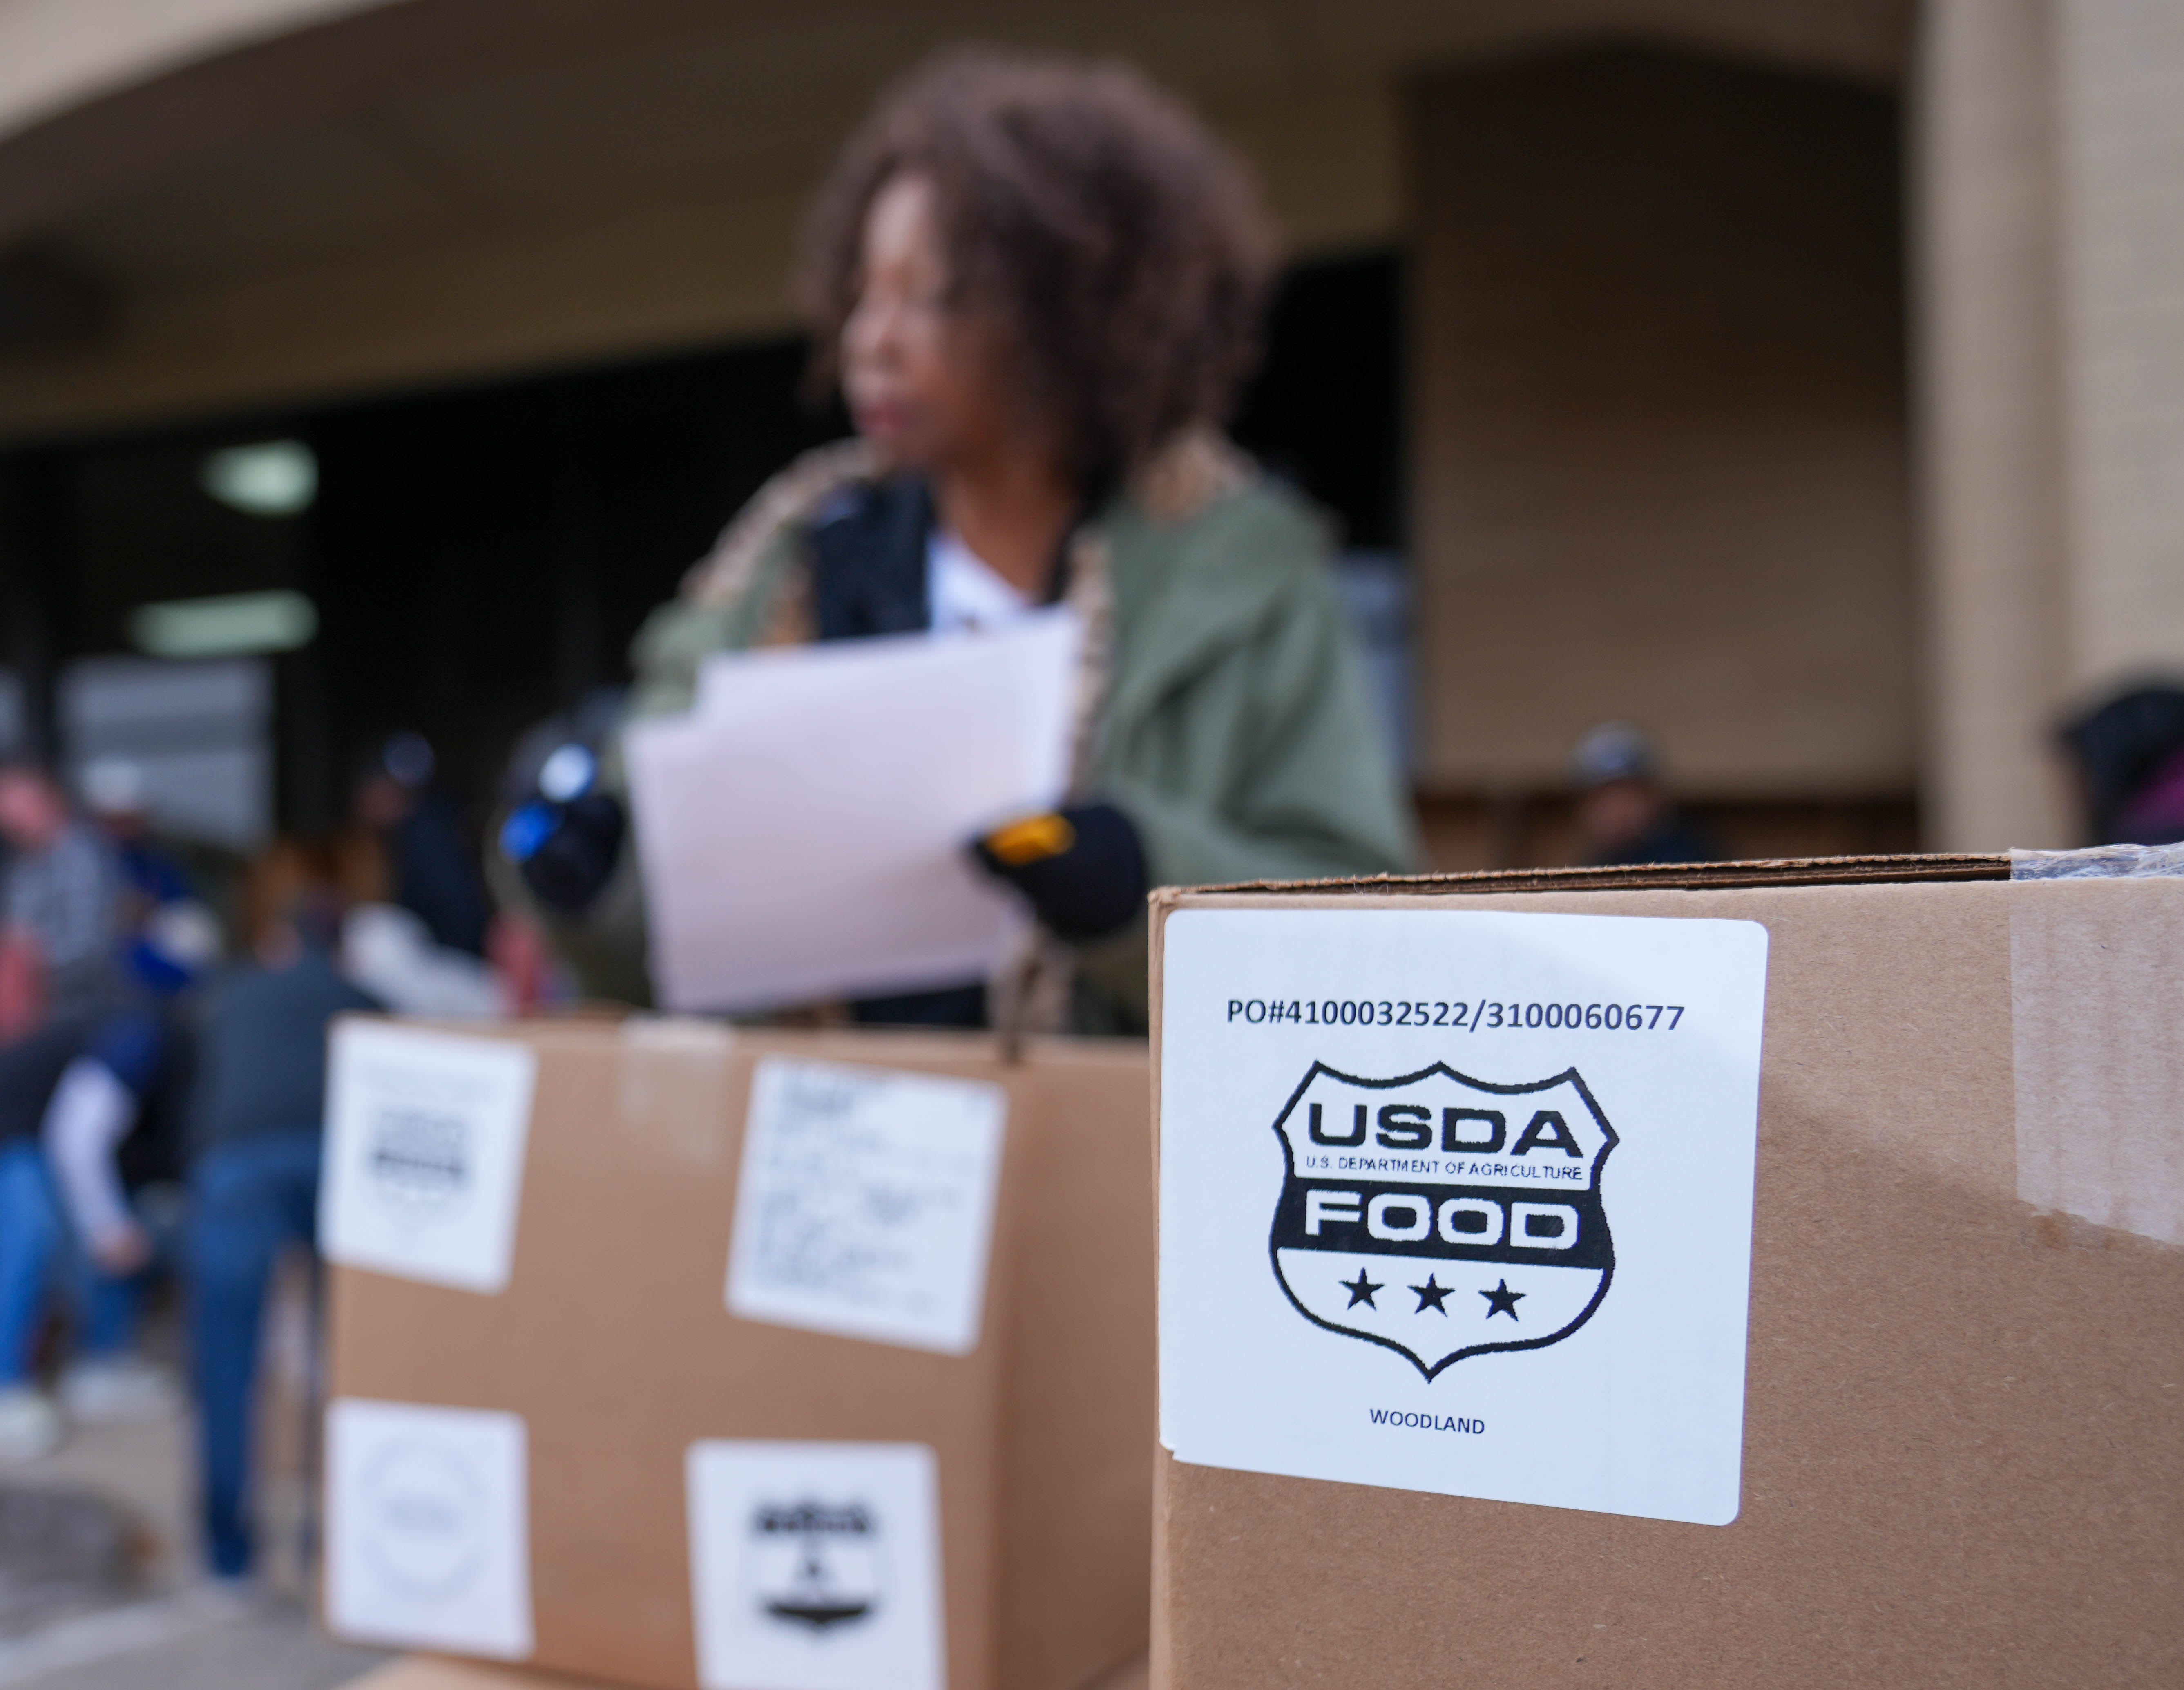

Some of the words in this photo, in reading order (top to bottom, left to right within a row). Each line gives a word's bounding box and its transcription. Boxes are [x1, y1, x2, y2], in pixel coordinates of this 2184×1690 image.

[1227, 999, 1685, 1033] PO#4100032522/3100060677
[1309, 1103, 1583, 1158] USDA
[1306, 1156, 1333, 1168] U.S.
[1338, 1156, 1440, 1174] DEPARTMENT
[1445, 1161, 1465, 1174] OF
[1468, 1162, 1583, 1180] AGRICULTURE
[1305, 1189, 1579, 1250] FOOD
[1369, 1408, 1485, 1435] WOODLAND
